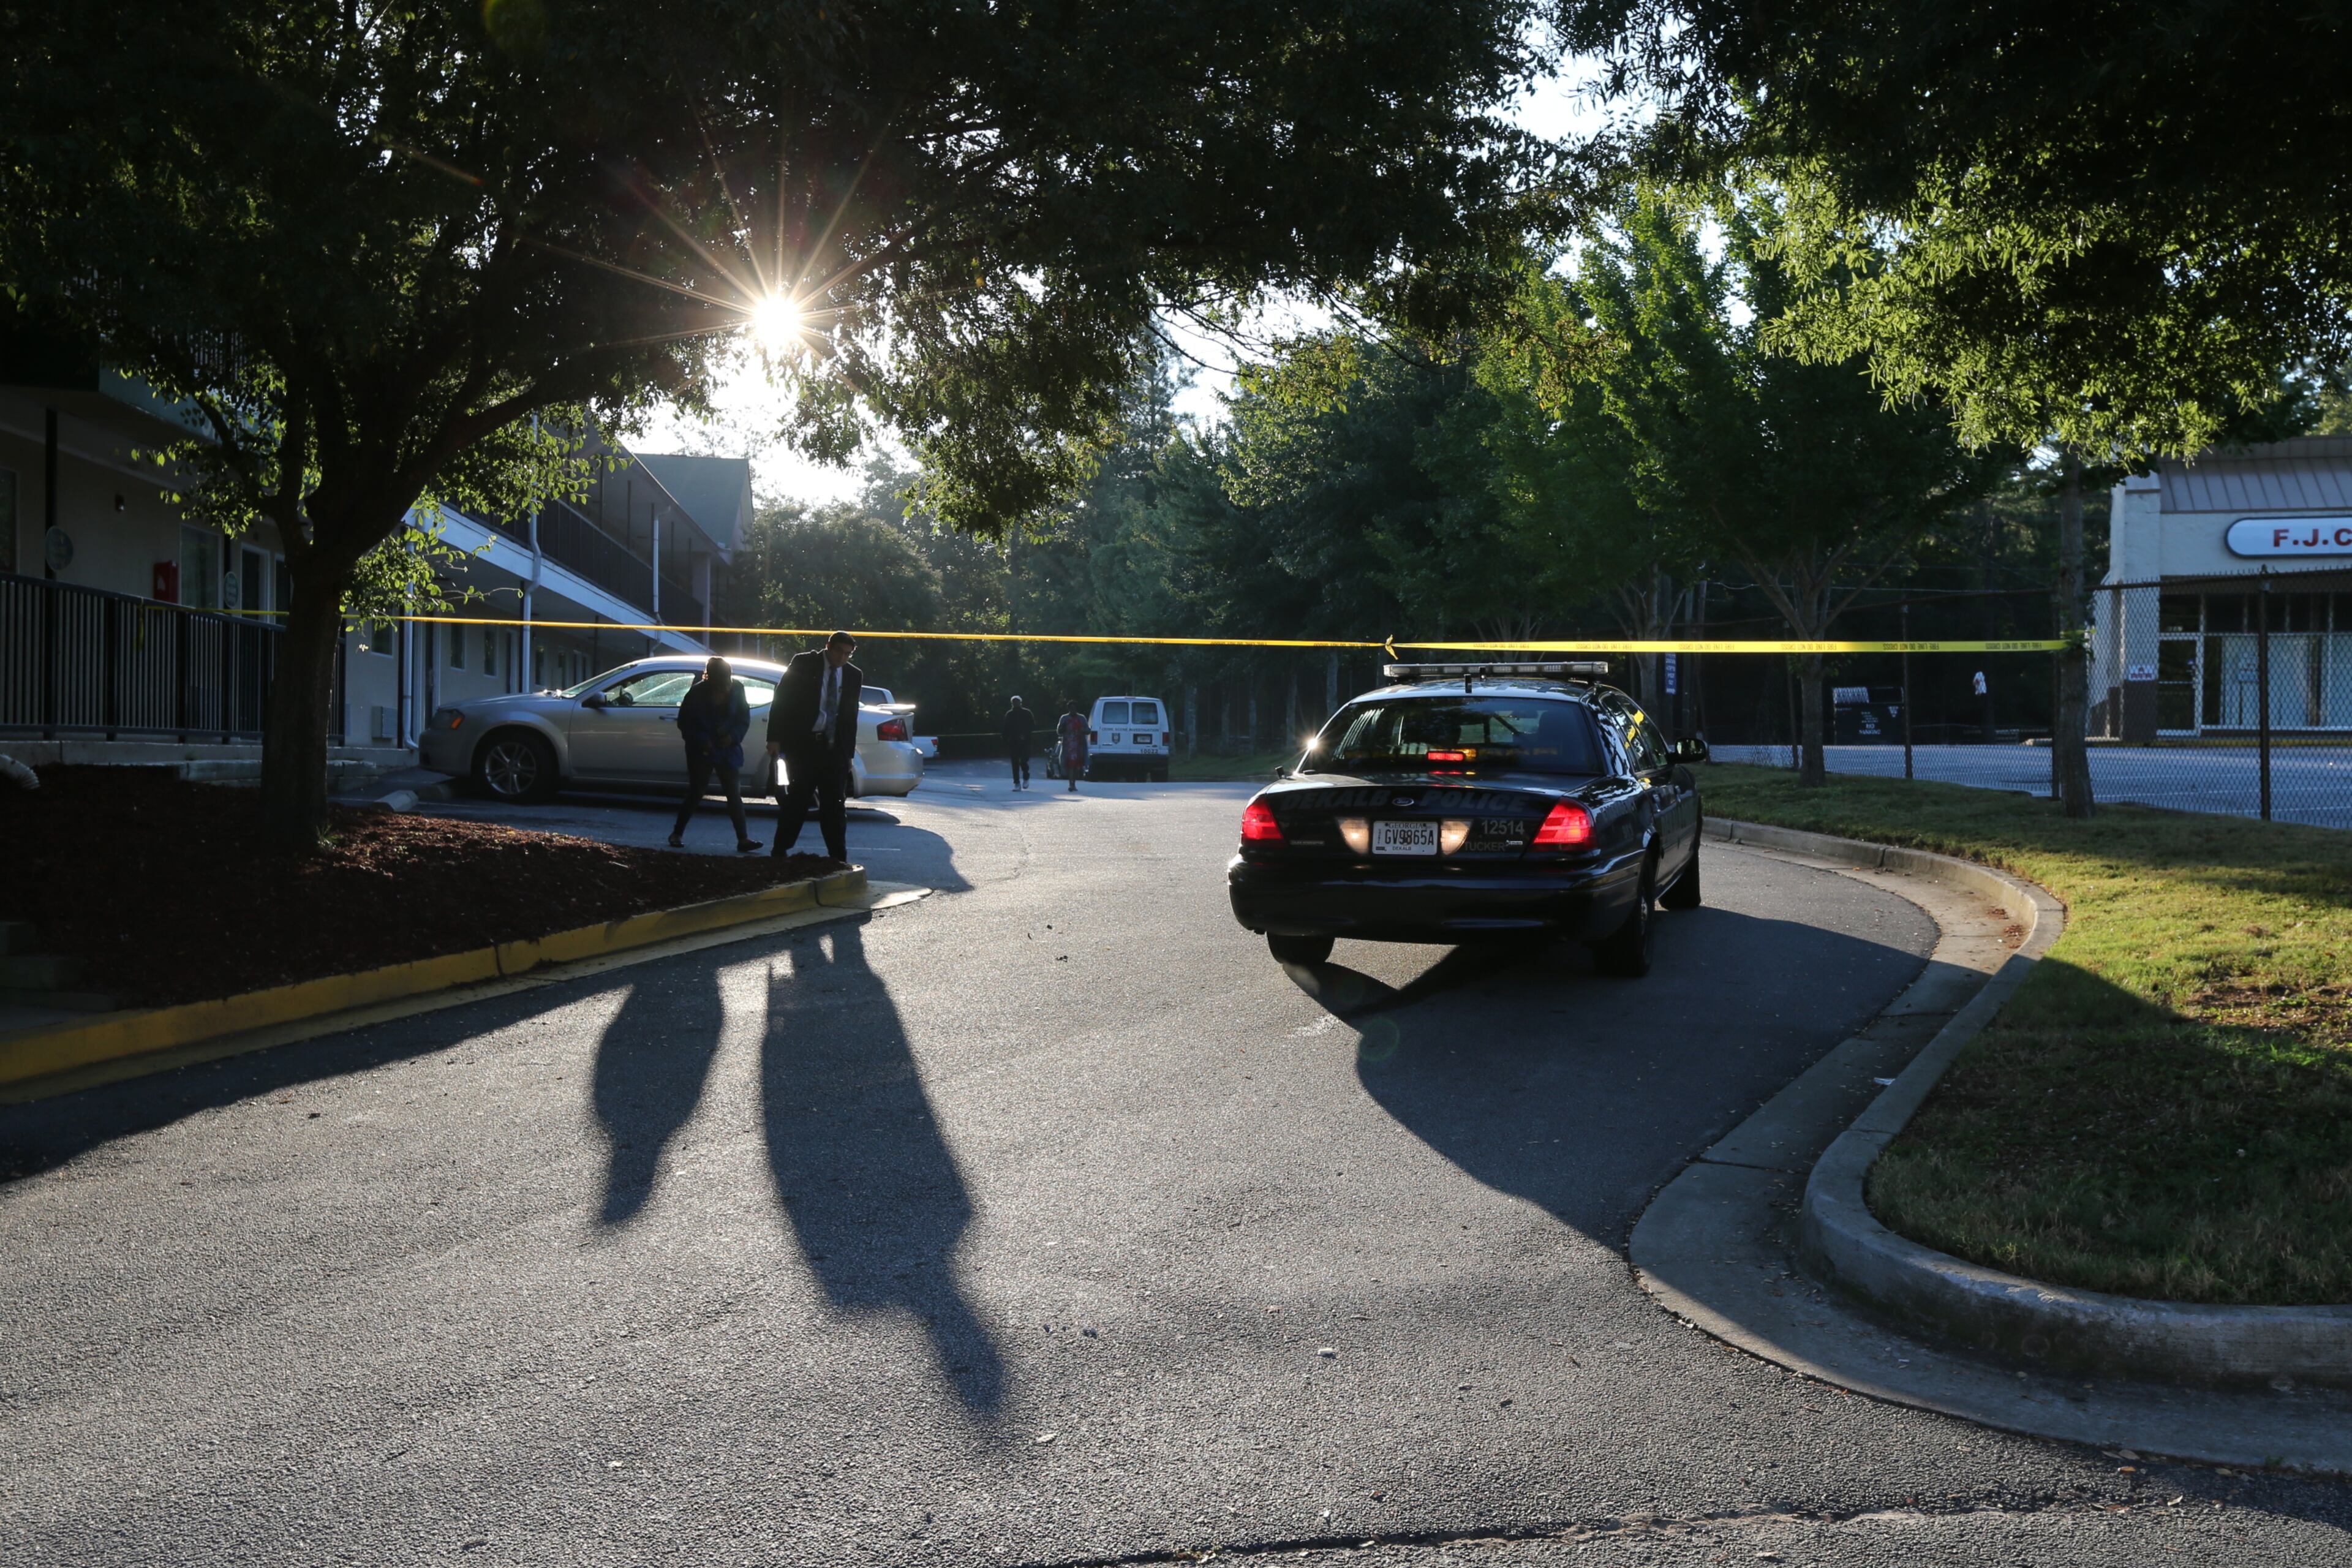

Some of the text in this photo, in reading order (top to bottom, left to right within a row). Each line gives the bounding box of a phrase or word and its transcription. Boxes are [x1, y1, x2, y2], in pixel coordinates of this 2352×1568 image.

[1280, 789, 1390, 810] DEKALB
[1419, 789, 1527, 813] POLICE
[1481, 820, 1525, 835] 12514
[1385, 829, 1434, 845] GV9865A
[1463, 841, 1507, 852] TUCKER
